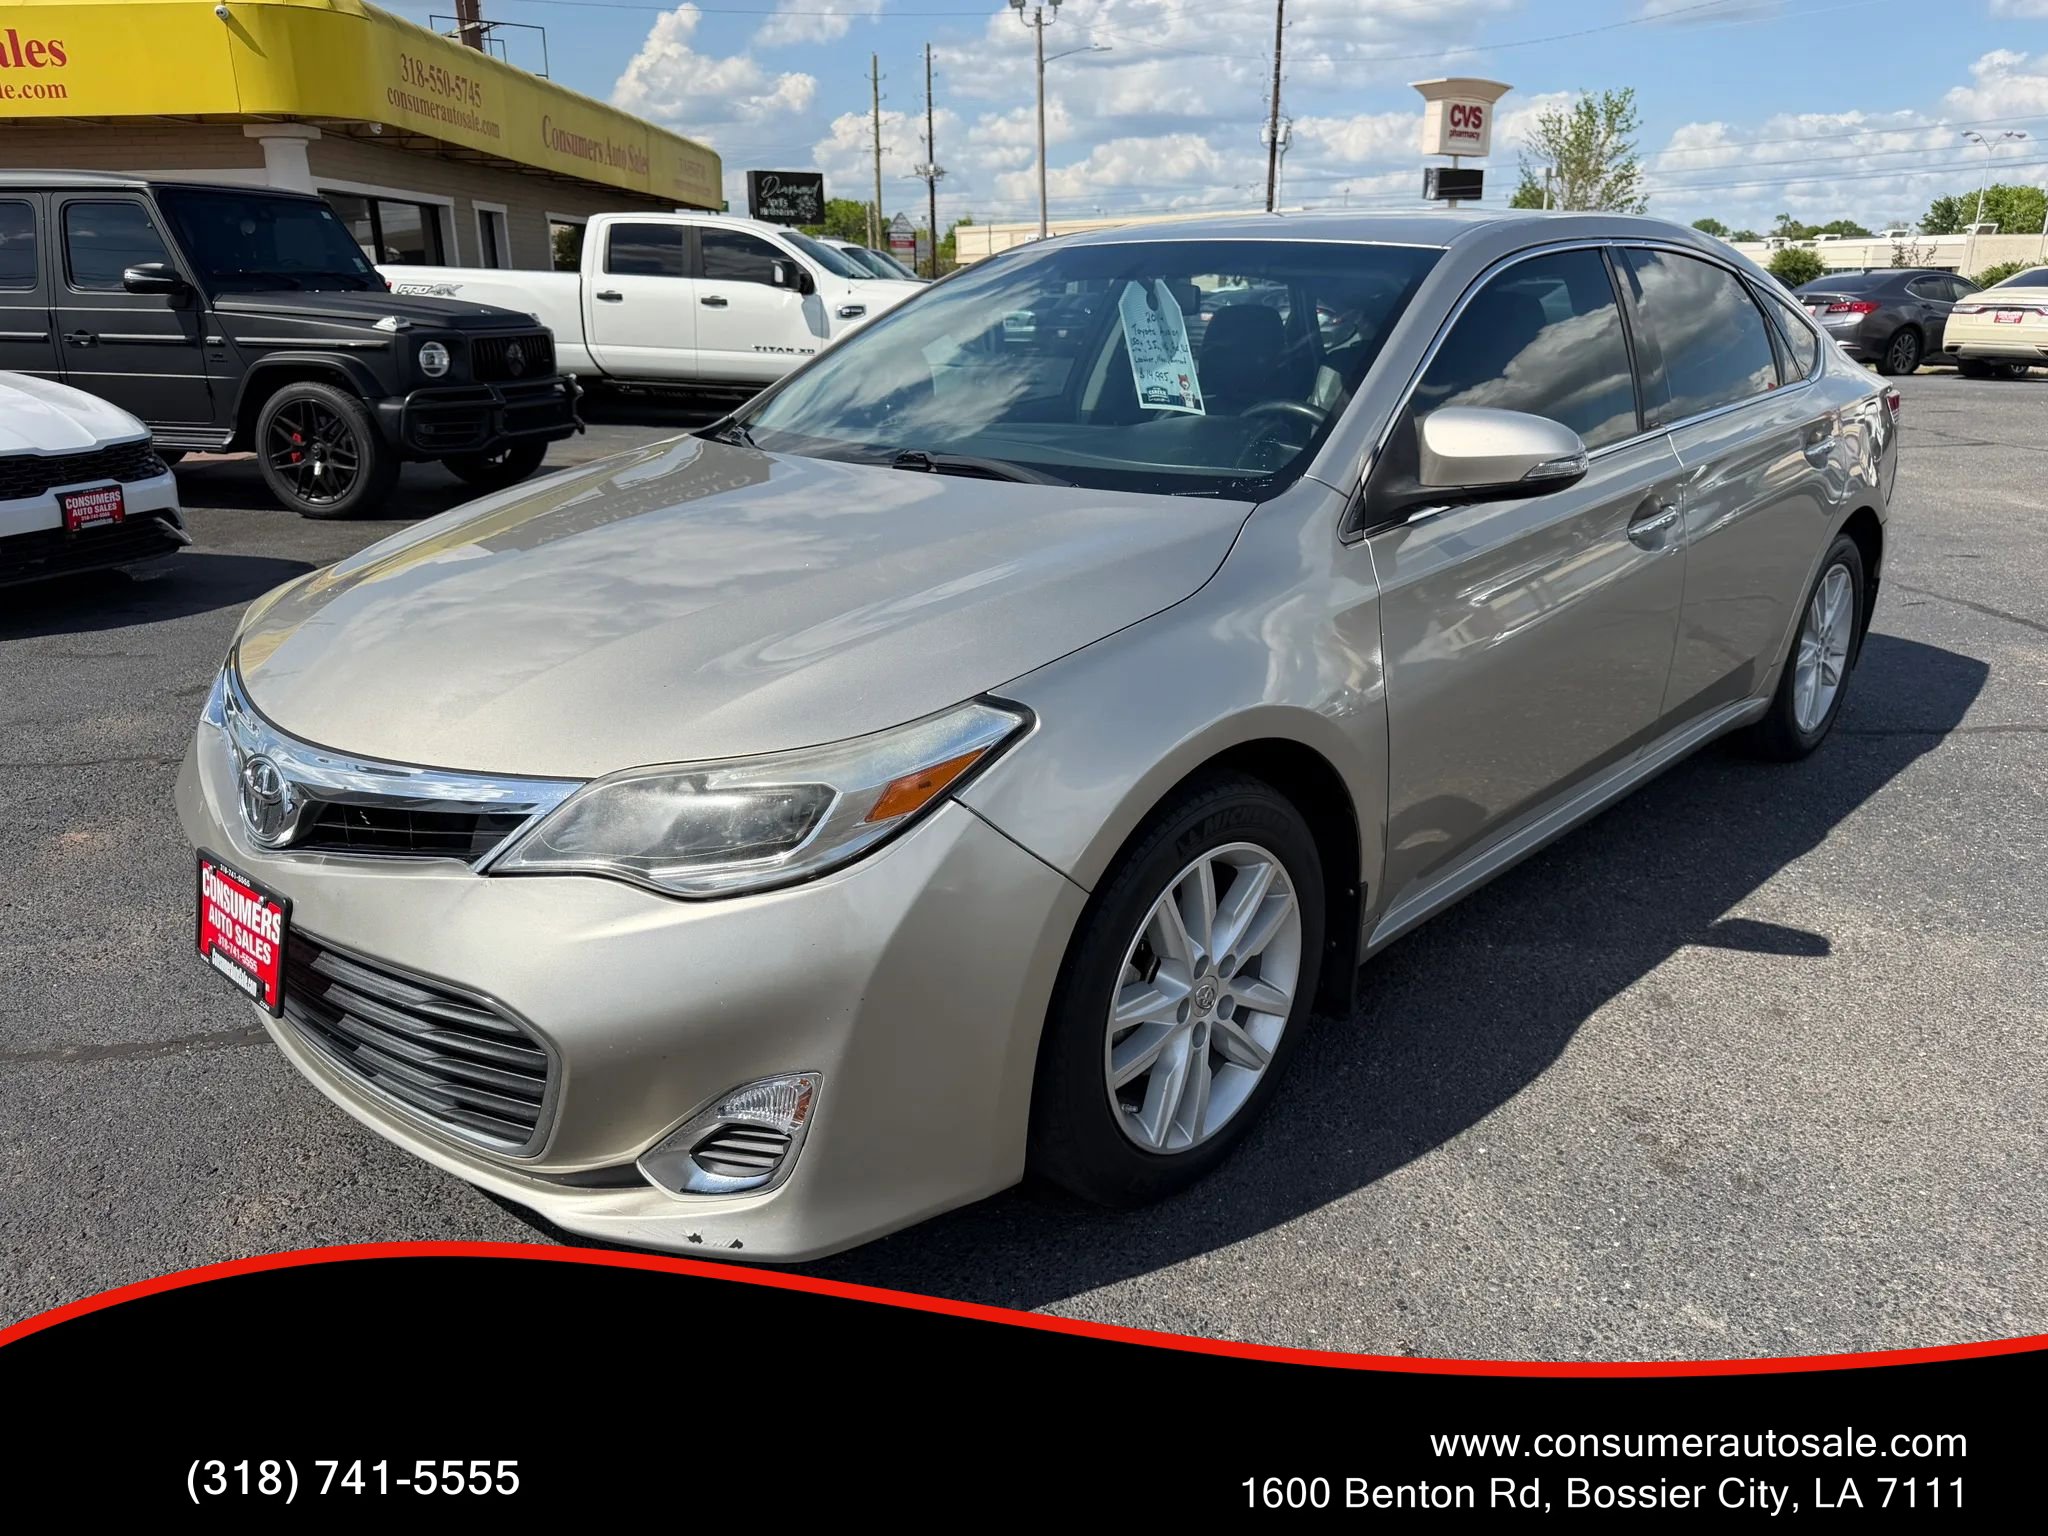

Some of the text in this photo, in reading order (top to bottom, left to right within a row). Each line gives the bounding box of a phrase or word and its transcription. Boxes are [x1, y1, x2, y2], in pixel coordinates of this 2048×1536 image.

[400, 53, 482, 108] 318-550-5745
[387, 87, 500, 139] consumerautosale.com
[1450, 104, 1483, 129] CVS
[543, 115, 603, 163] Consumers
[604, 136, 627, 170] Auto
[1449, 129, 1480, 140] pharmacy
[754, 345, 794, 353] TITAN
[65, 491, 121, 510] CONSUMERS
[72, 502, 118, 517] AUTO SALES
[202, 867, 282, 945] CONSUMERS
[208, 903, 272, 965] AUTO SALES
[217, 933, 258, 973] 318-741-5555
